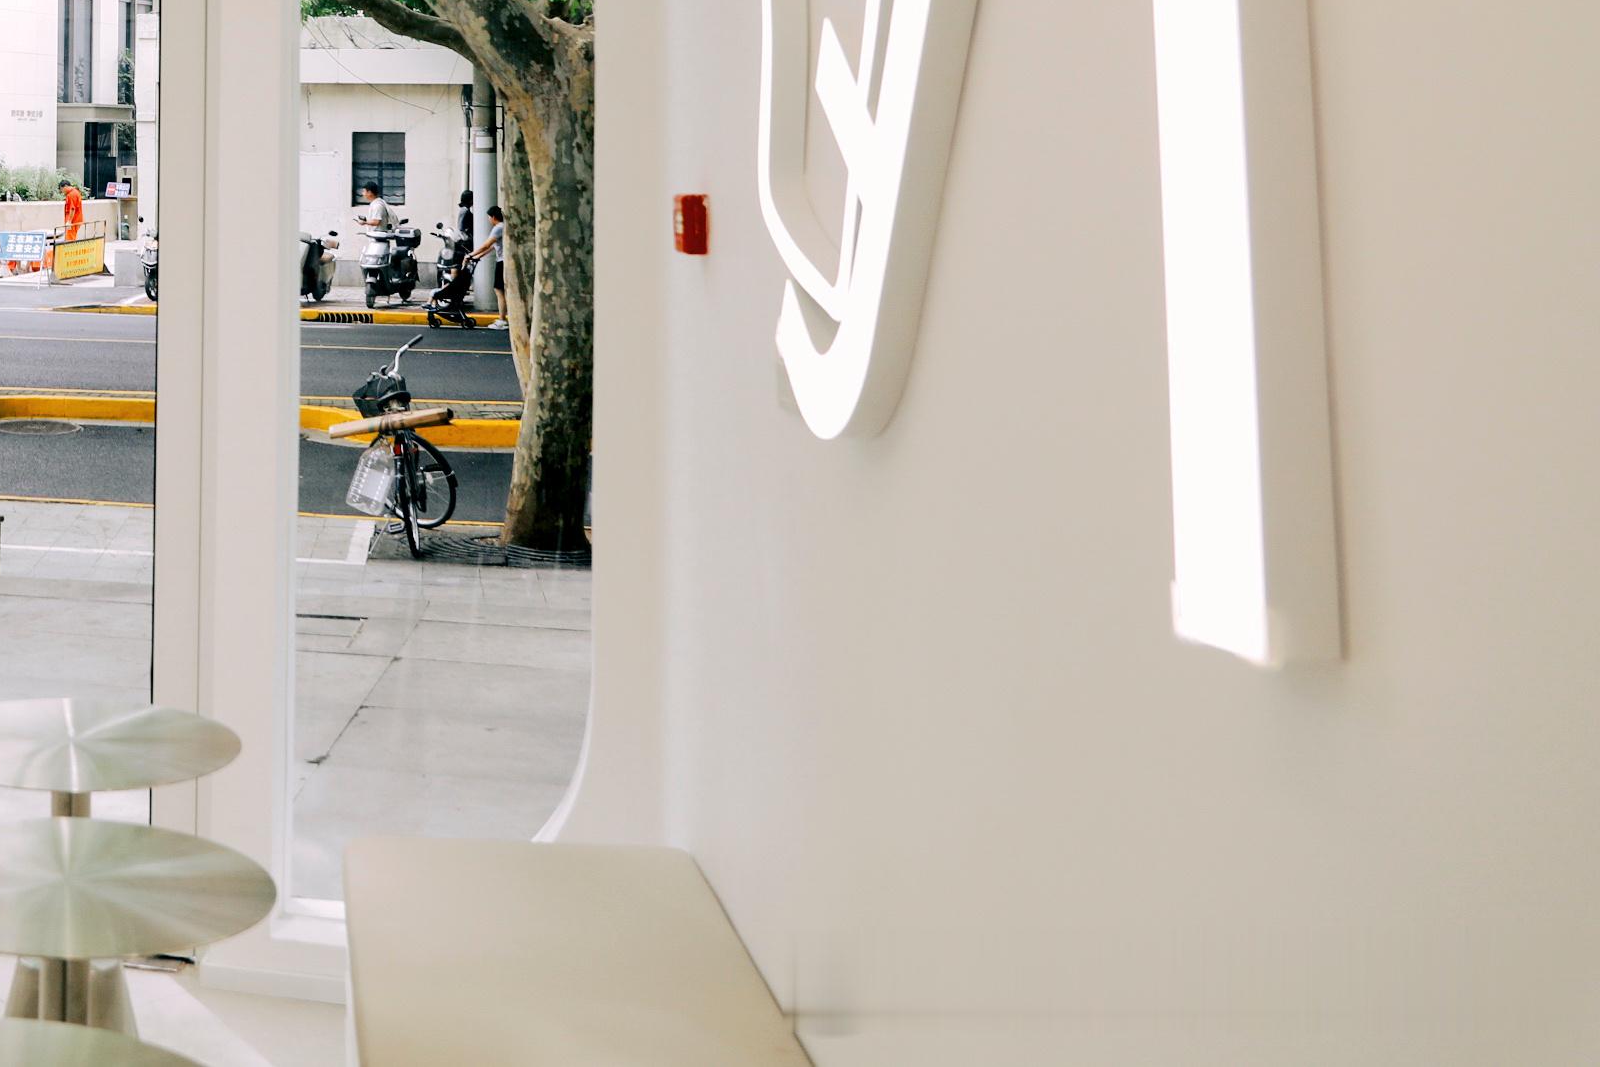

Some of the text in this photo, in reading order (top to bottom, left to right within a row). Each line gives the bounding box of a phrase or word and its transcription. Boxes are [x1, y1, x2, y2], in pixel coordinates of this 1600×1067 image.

[7, 234, 43, 244] 正在施工
[6, 244, 41, 254] 注意安全
